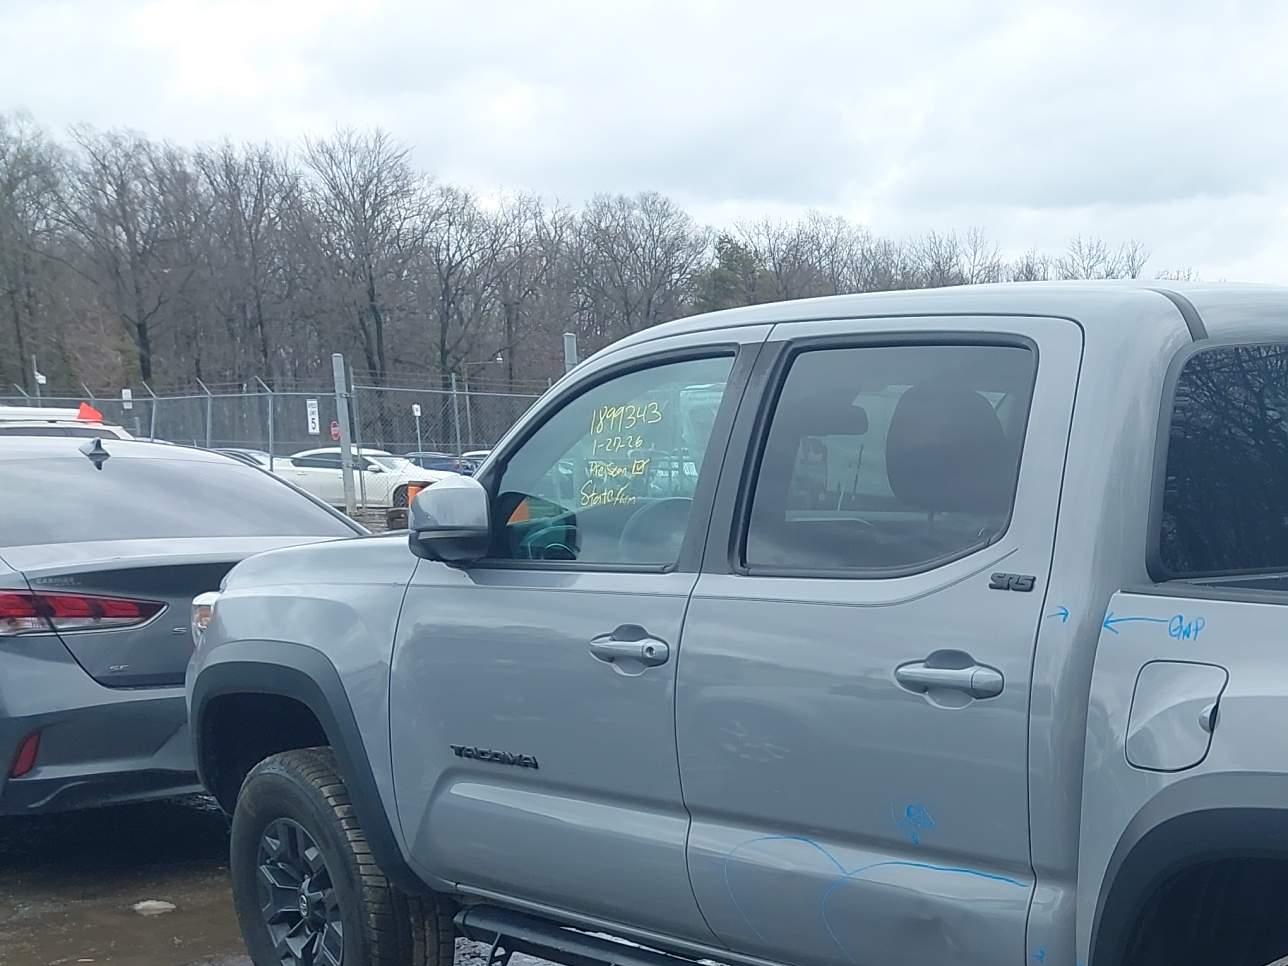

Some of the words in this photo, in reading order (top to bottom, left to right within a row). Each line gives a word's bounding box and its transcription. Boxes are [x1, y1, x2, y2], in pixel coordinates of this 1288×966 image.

[590, 402, 662, 435] 1899343
[989, 572, 1036, 592] SR5
[449, 743, 540, 770] TACOMA
